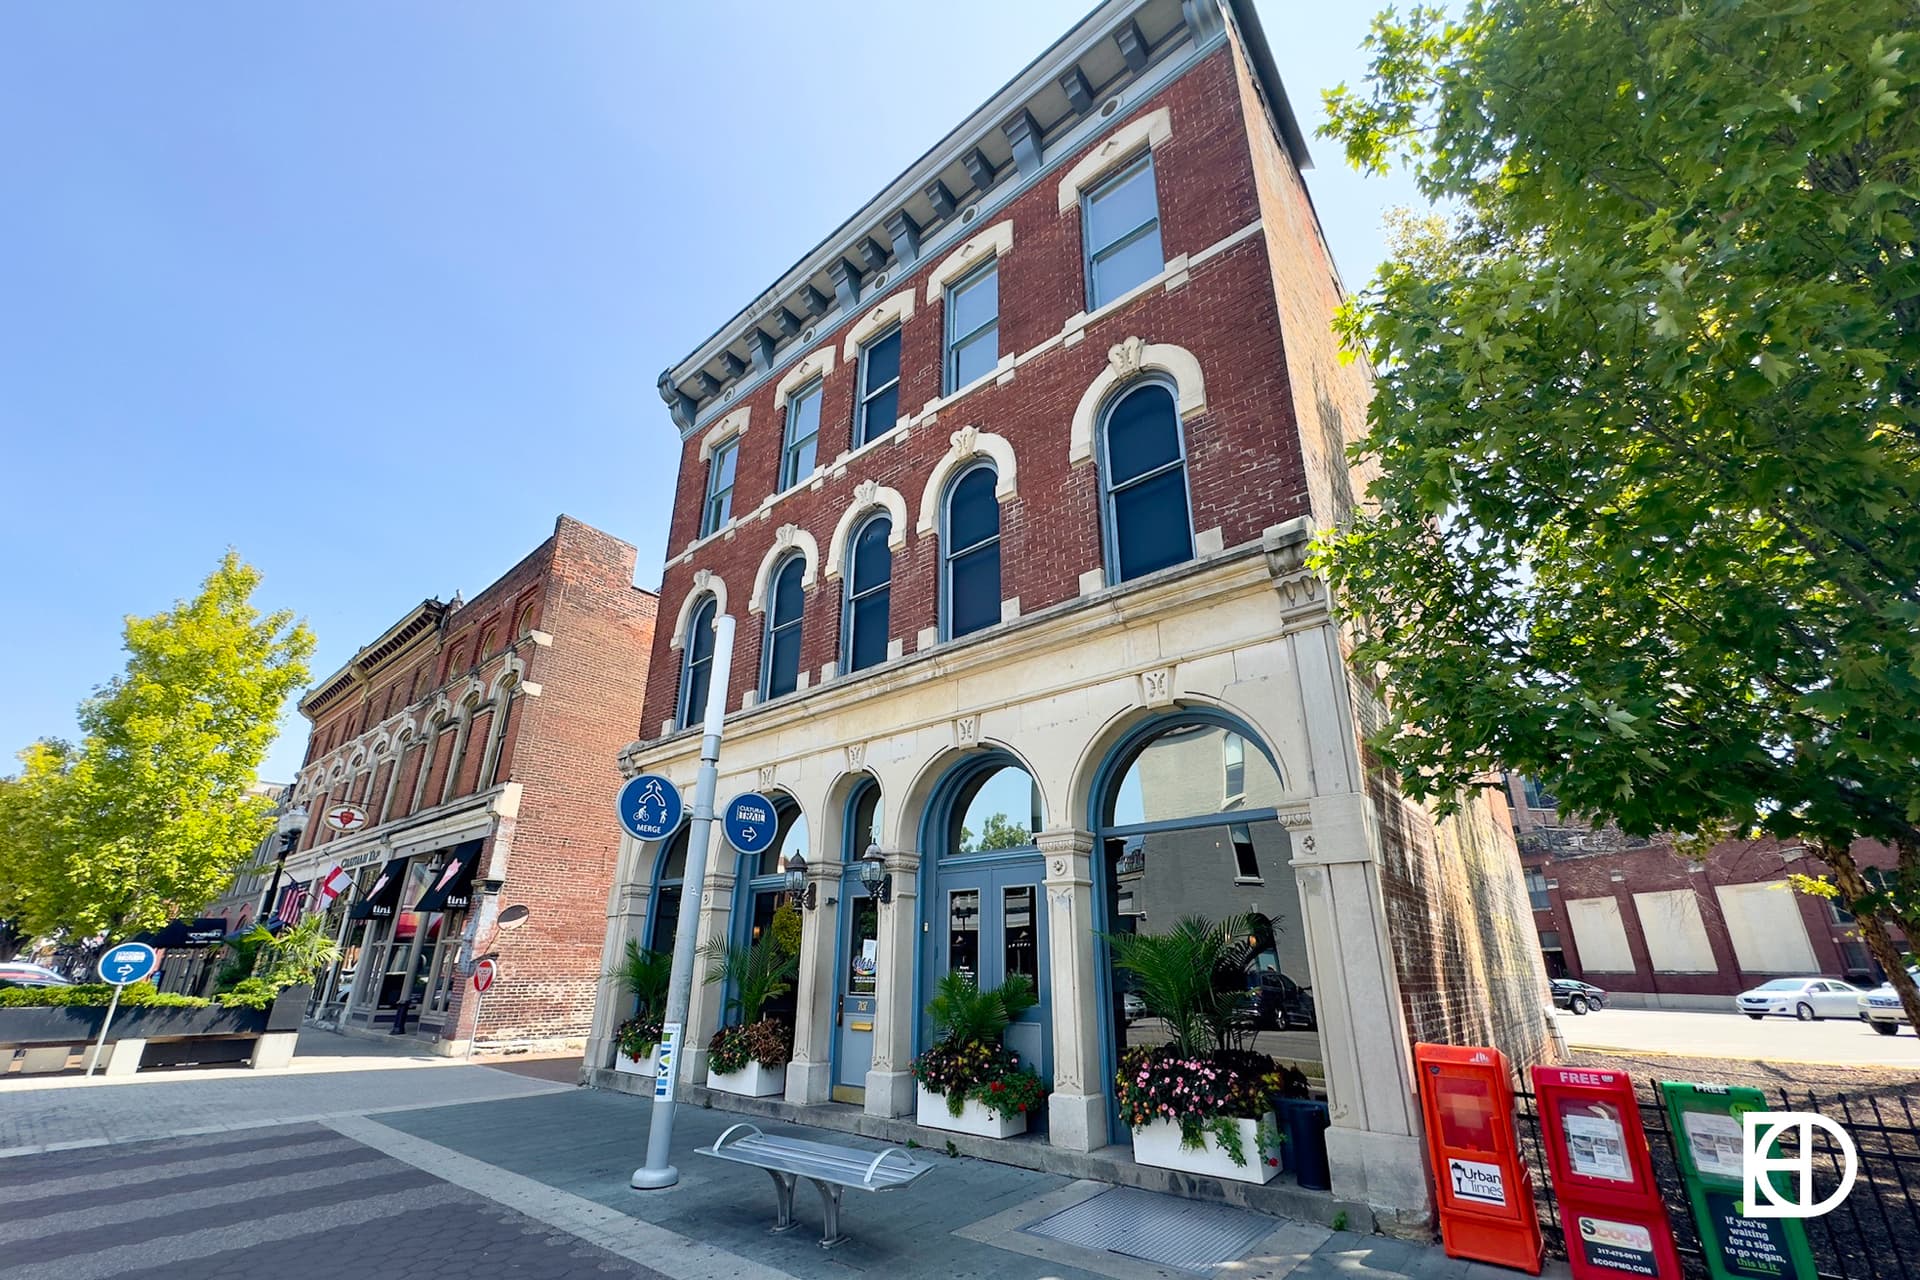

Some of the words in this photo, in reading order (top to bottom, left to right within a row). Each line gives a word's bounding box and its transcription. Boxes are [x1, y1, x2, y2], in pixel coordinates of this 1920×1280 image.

[739, 804, 765, 814] CULTURAL
[636, 823, 661, 834] MERGE
[1560, 1072, 1601, 1086] FREE
[1695, 1084, 1728, 1094] FREE
[1463, 1167, 1502, 1185] Urban
[1470, 1180, 1504, 1196] Times
[1725, 1215, 1734, 1225] If
[1735, 1217, 1767, 1230] you're
[1730, 1227, 1769, 1241] waiting
[1729, 1236, 1744, 1246] for
[1746, 1240, 1753, 1248] a
[1754, 1241, 1776, 1252] sign
[1724, 1246, 1736, 1255] to
[1737, 1249, 1750, 1258] go
[1736, 1258, 1756, 1268] this
[1757, 1260, 1767, 1270] is
